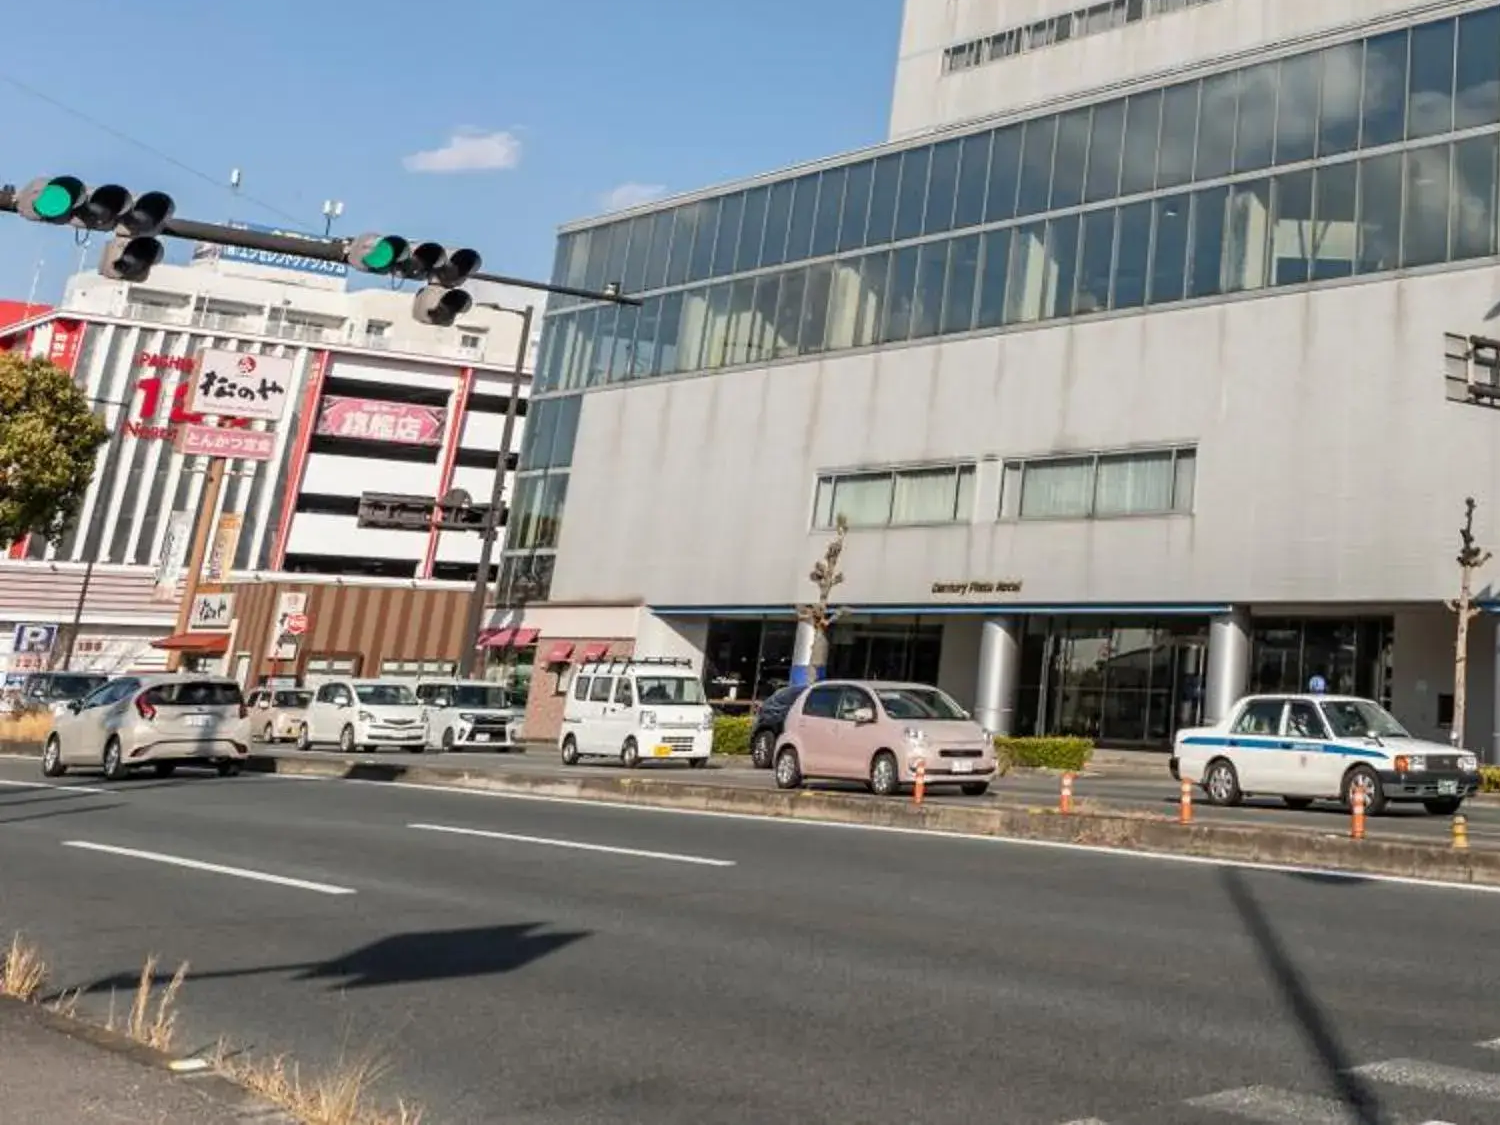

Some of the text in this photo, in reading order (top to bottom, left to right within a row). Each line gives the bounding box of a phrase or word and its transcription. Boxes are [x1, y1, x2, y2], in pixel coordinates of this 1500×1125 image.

[199, 370, 284, 400] 松のや
[22, 626, 49, 652] P
